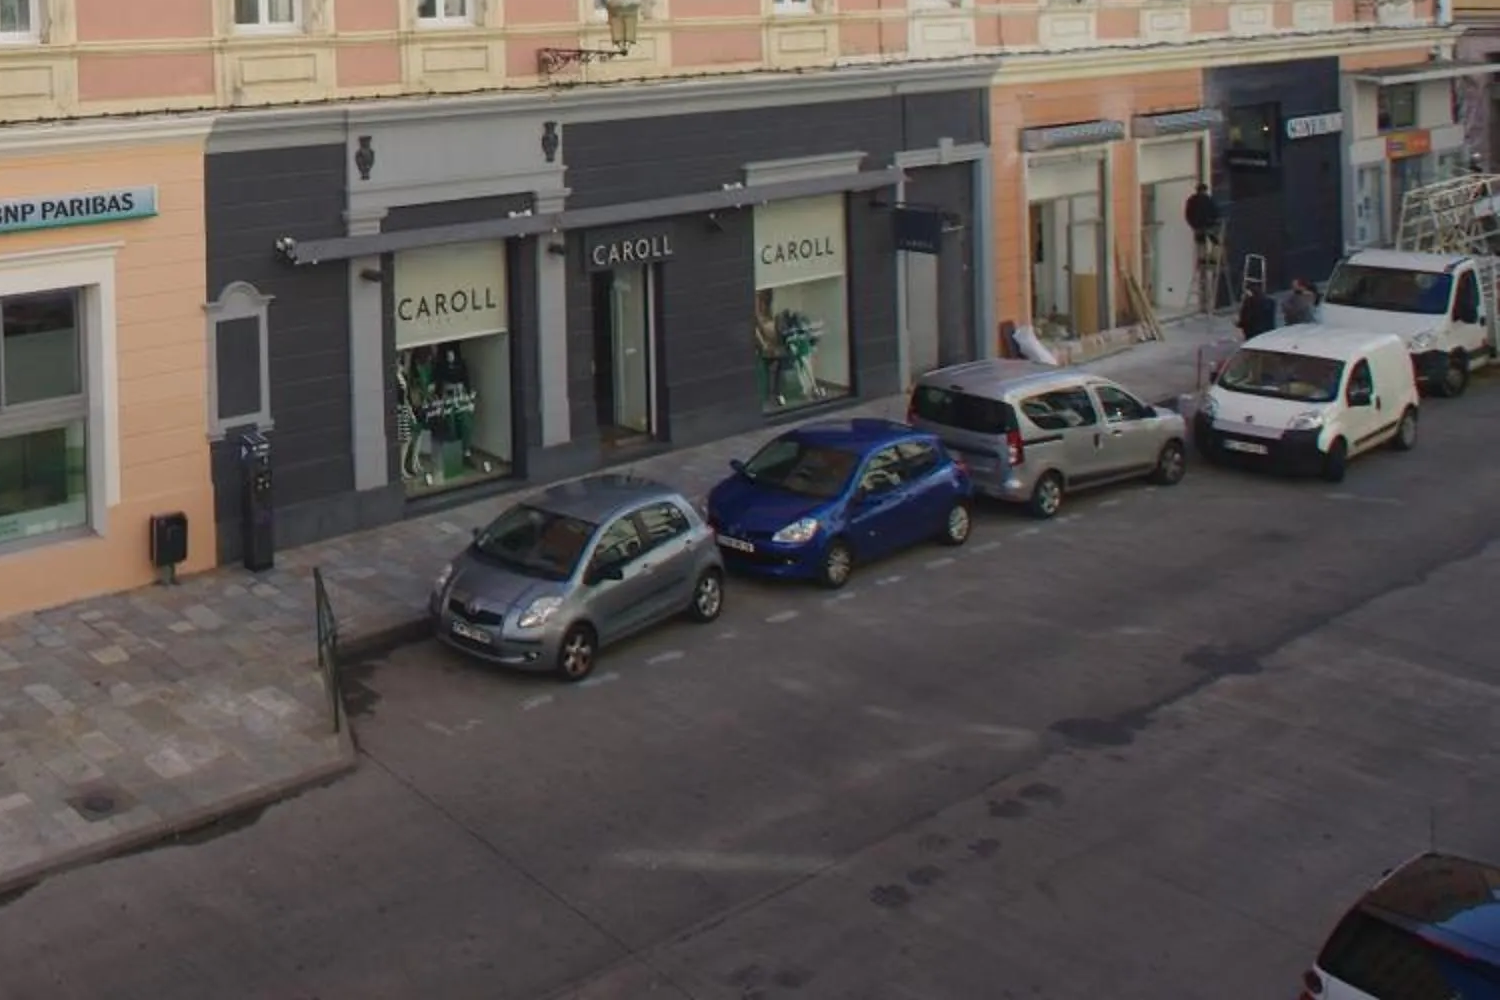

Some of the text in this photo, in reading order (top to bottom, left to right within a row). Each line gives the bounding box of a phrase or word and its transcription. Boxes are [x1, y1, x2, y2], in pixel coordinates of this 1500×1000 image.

[41, 192, 134, 220] PARIBAS
[593, 235, 673, 266] CAROLL
[761, 236, 835, 265] CAROLL
[398, 287, 496, 321] CAROLL
